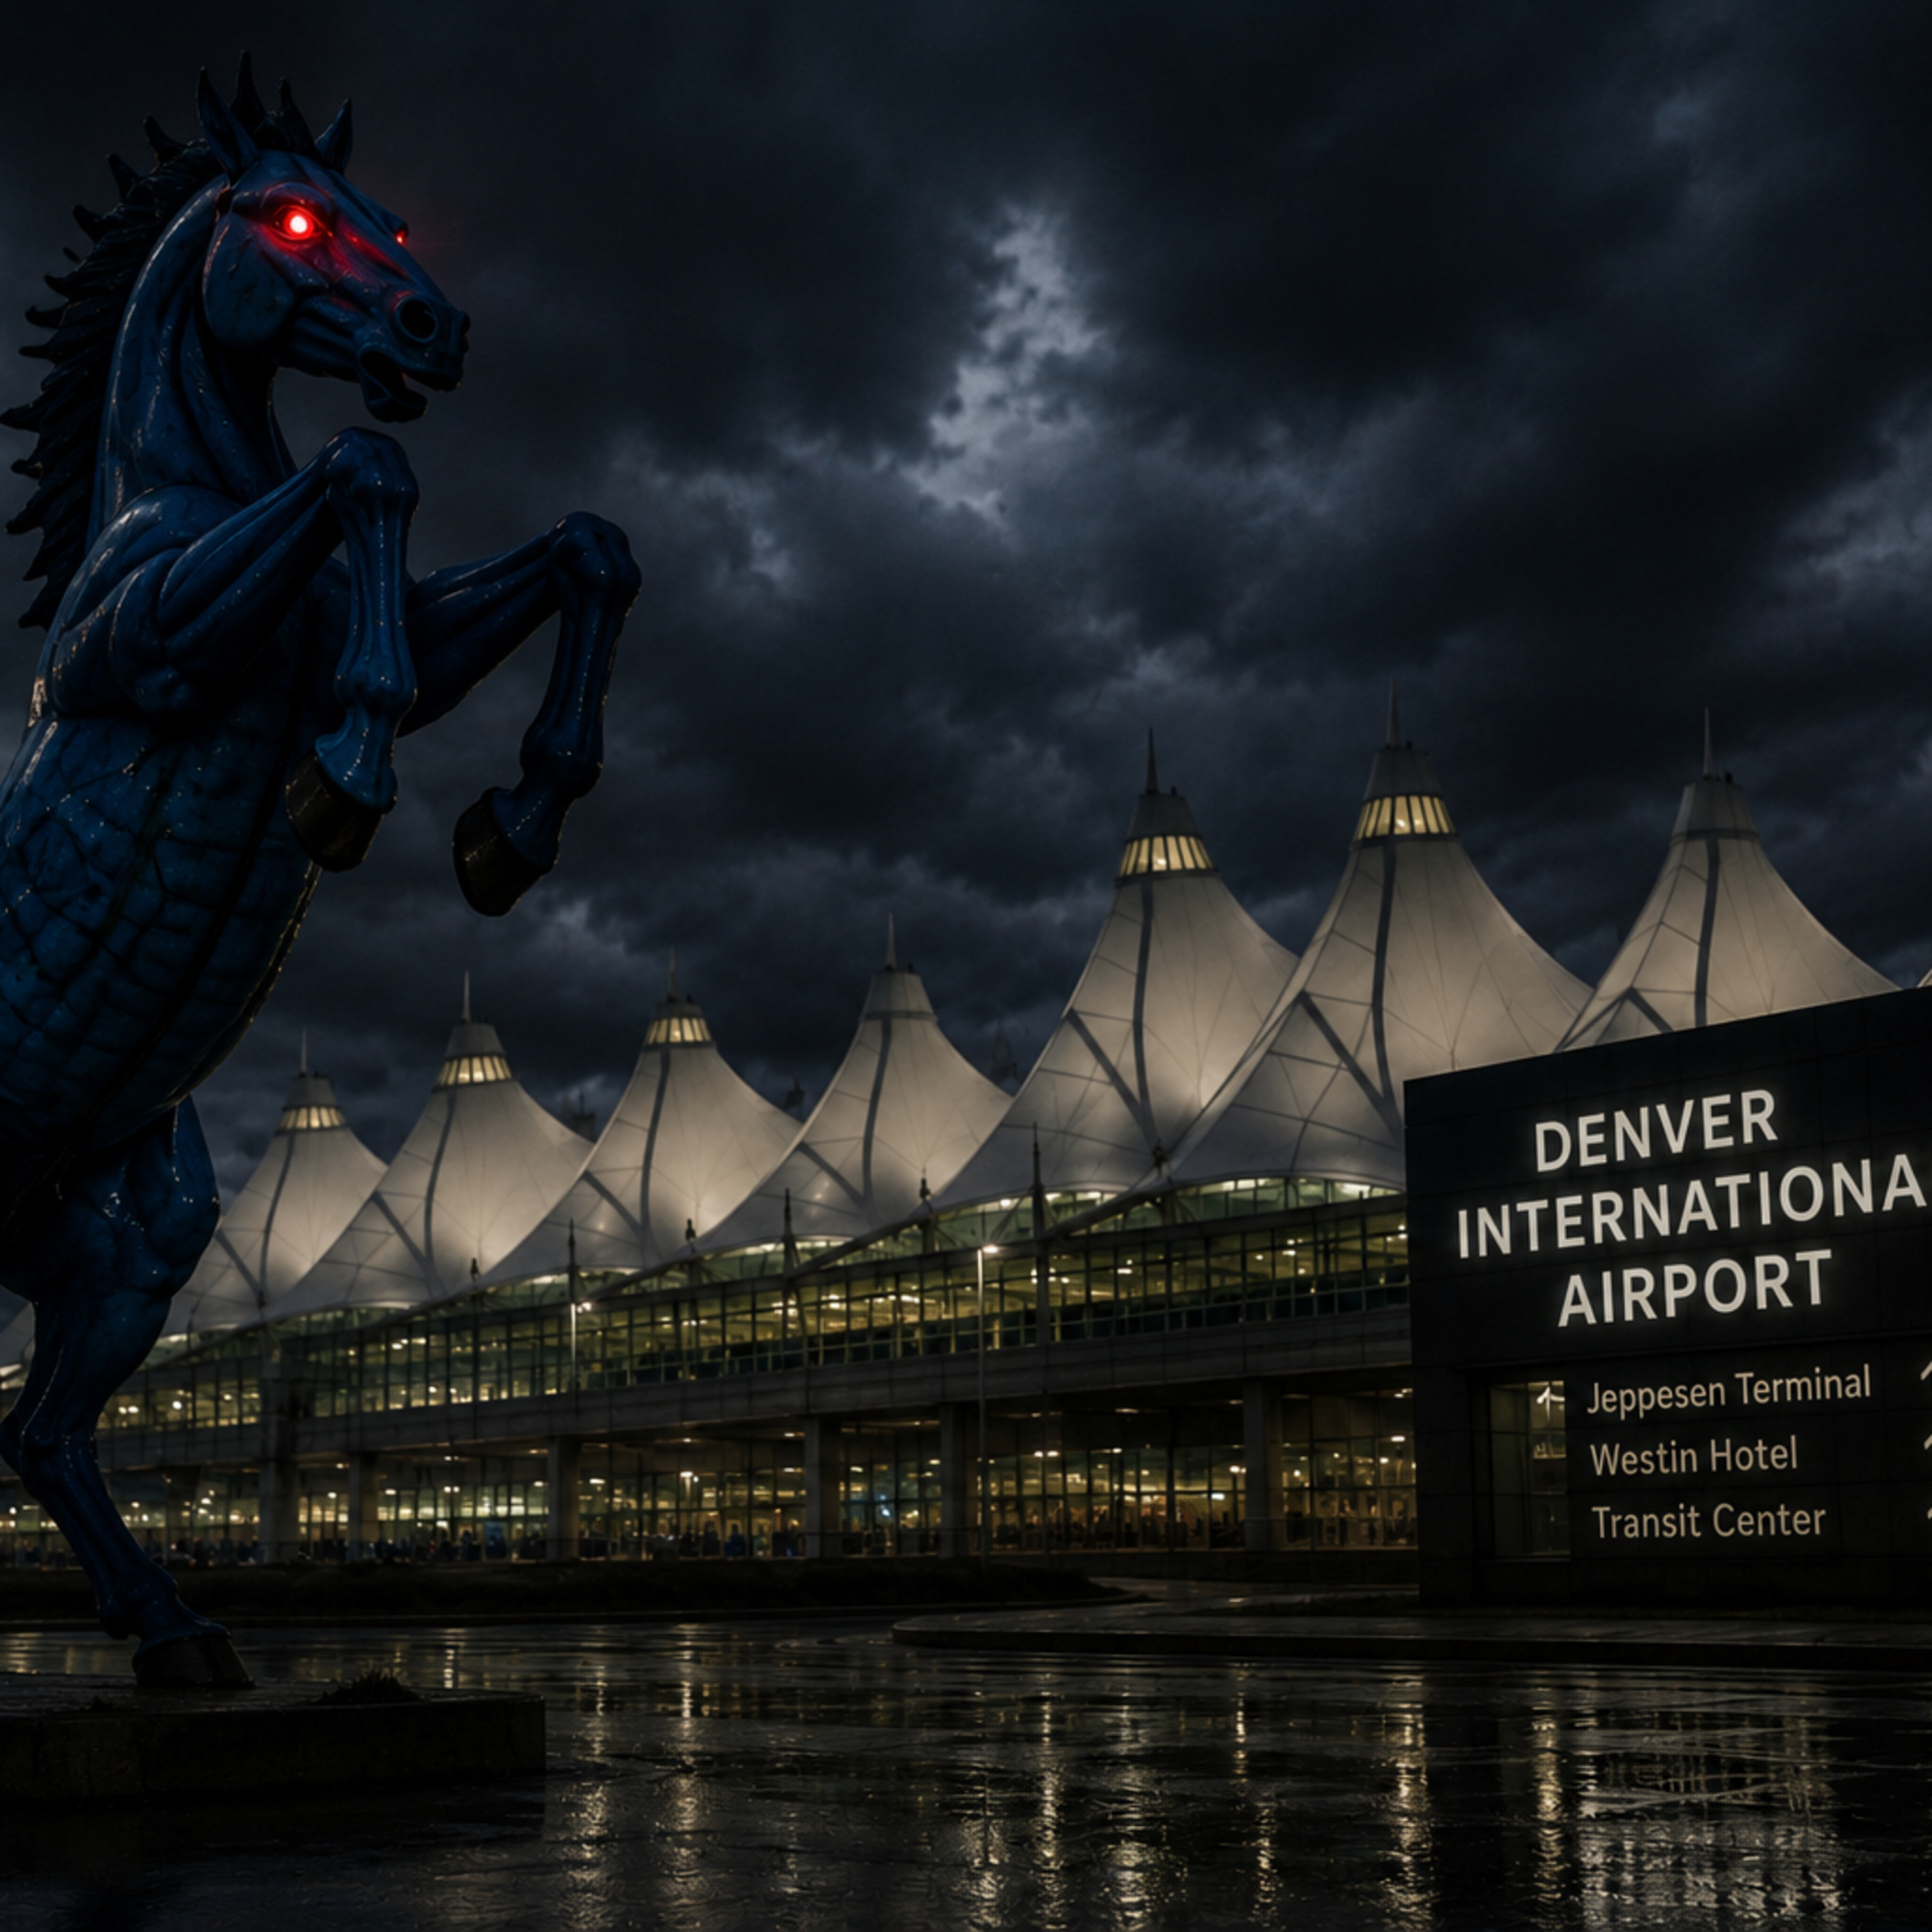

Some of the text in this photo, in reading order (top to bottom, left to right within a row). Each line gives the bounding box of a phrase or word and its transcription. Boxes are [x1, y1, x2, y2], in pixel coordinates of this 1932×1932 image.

[1535, 1089, 1779, 1173] DENVER
[1457, 1153, 1927, 1259] INTERNATIONA
[1557, 1249, 1833, 1328] AIRPORT
[1587, 1363, 1871, 1421] Jeppesen Terminal
[1589, 1435, 1798, 1476] Westin Hotel
[1591, 1502, 1827, 1539] Transit Center
